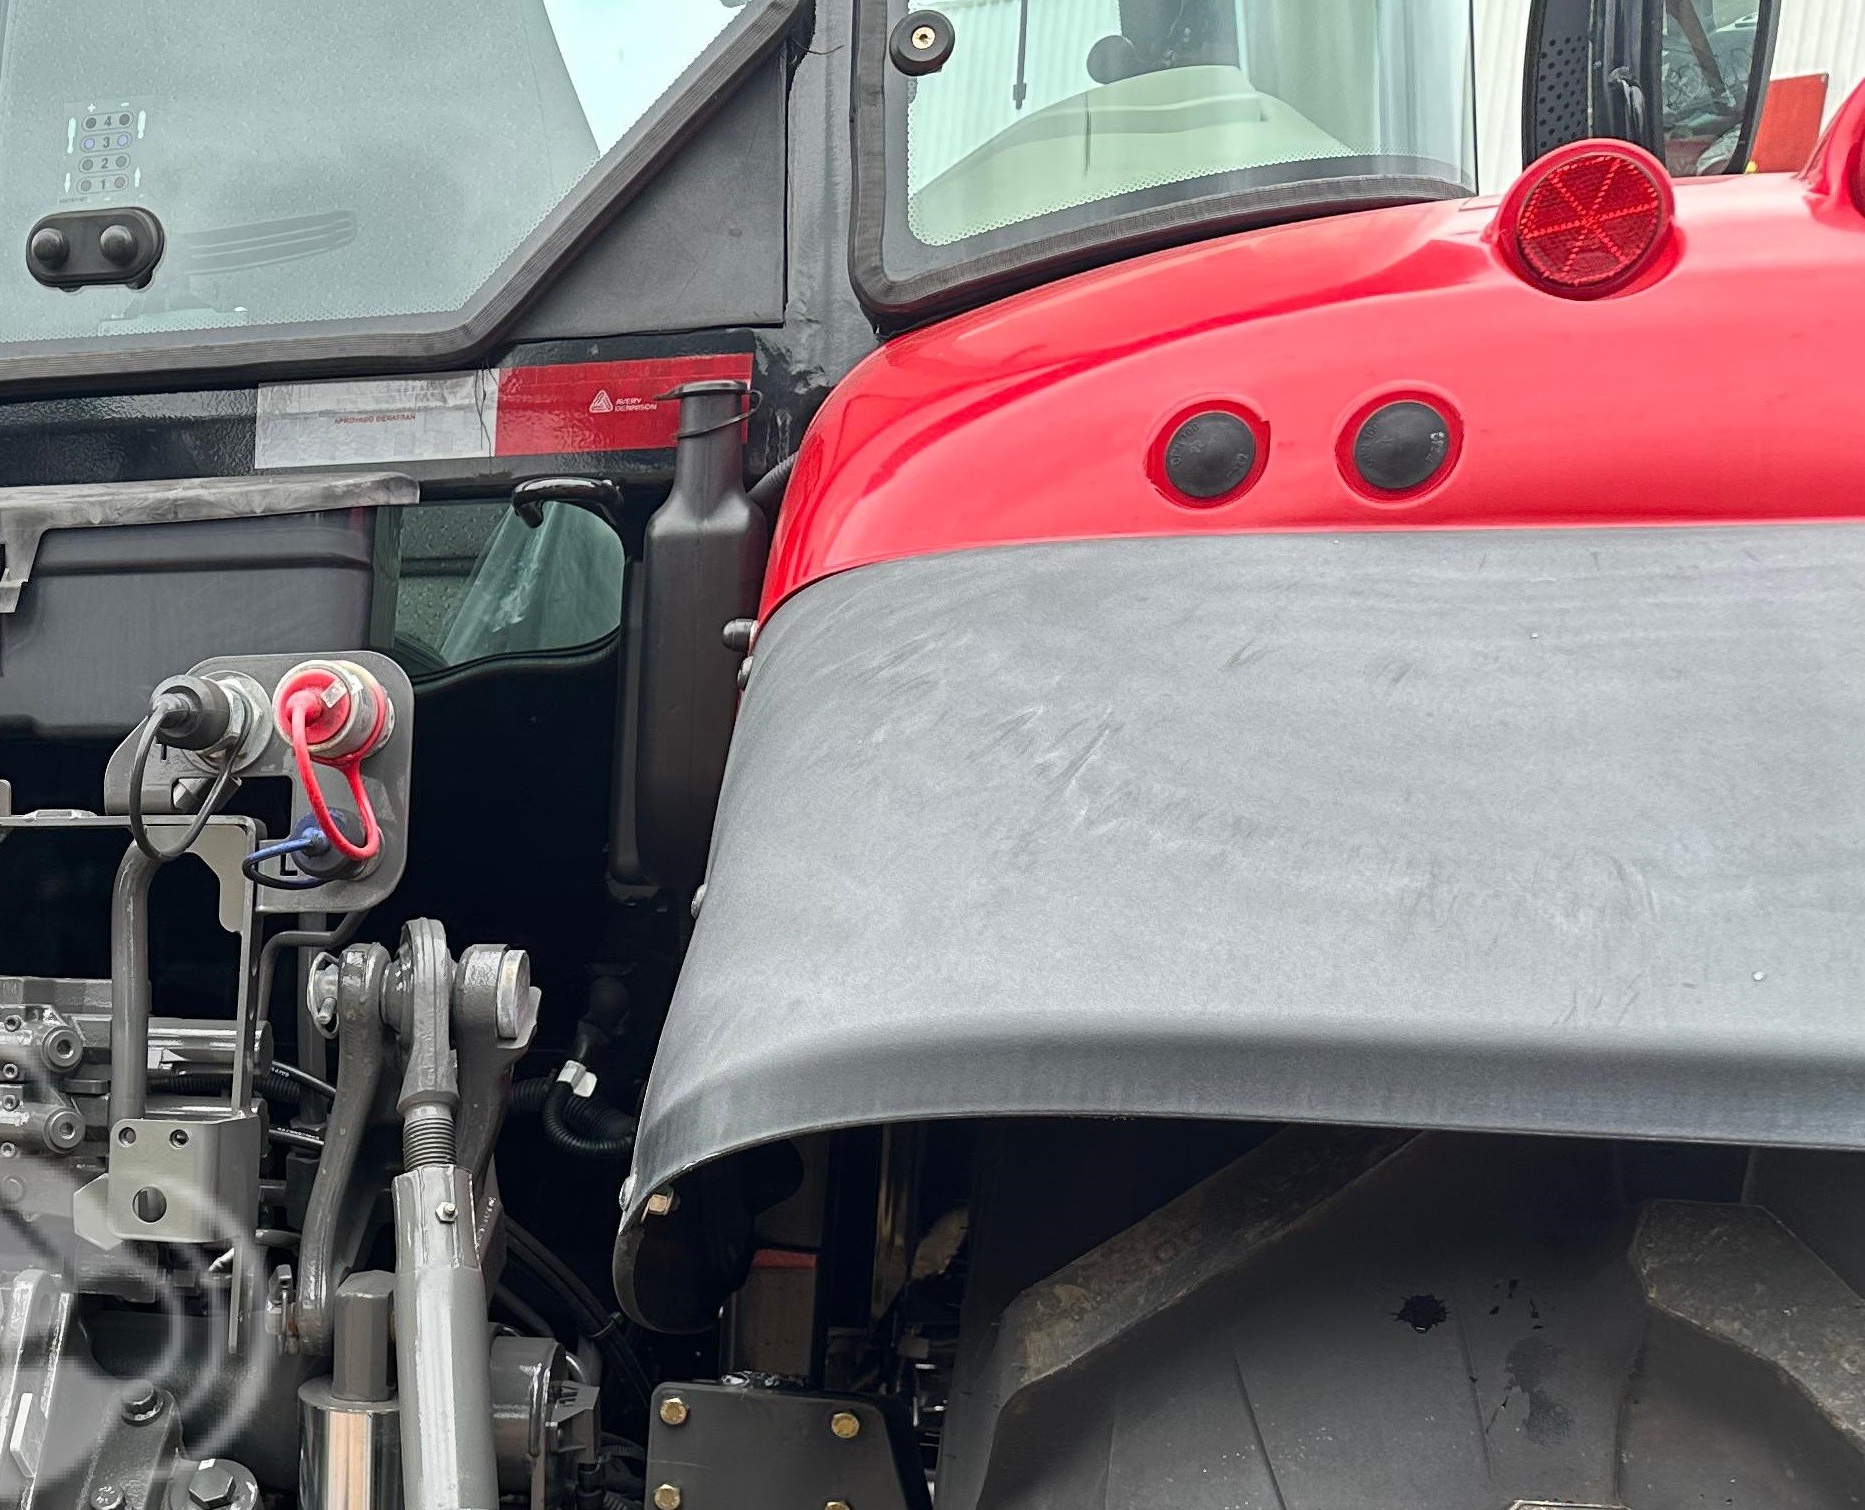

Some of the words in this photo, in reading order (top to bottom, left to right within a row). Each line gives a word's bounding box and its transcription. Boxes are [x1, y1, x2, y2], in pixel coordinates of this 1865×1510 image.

[104, 116, 112, 126] 4
[103, 136, 110, 148] 3
[101, 158, 109, 169] 2
